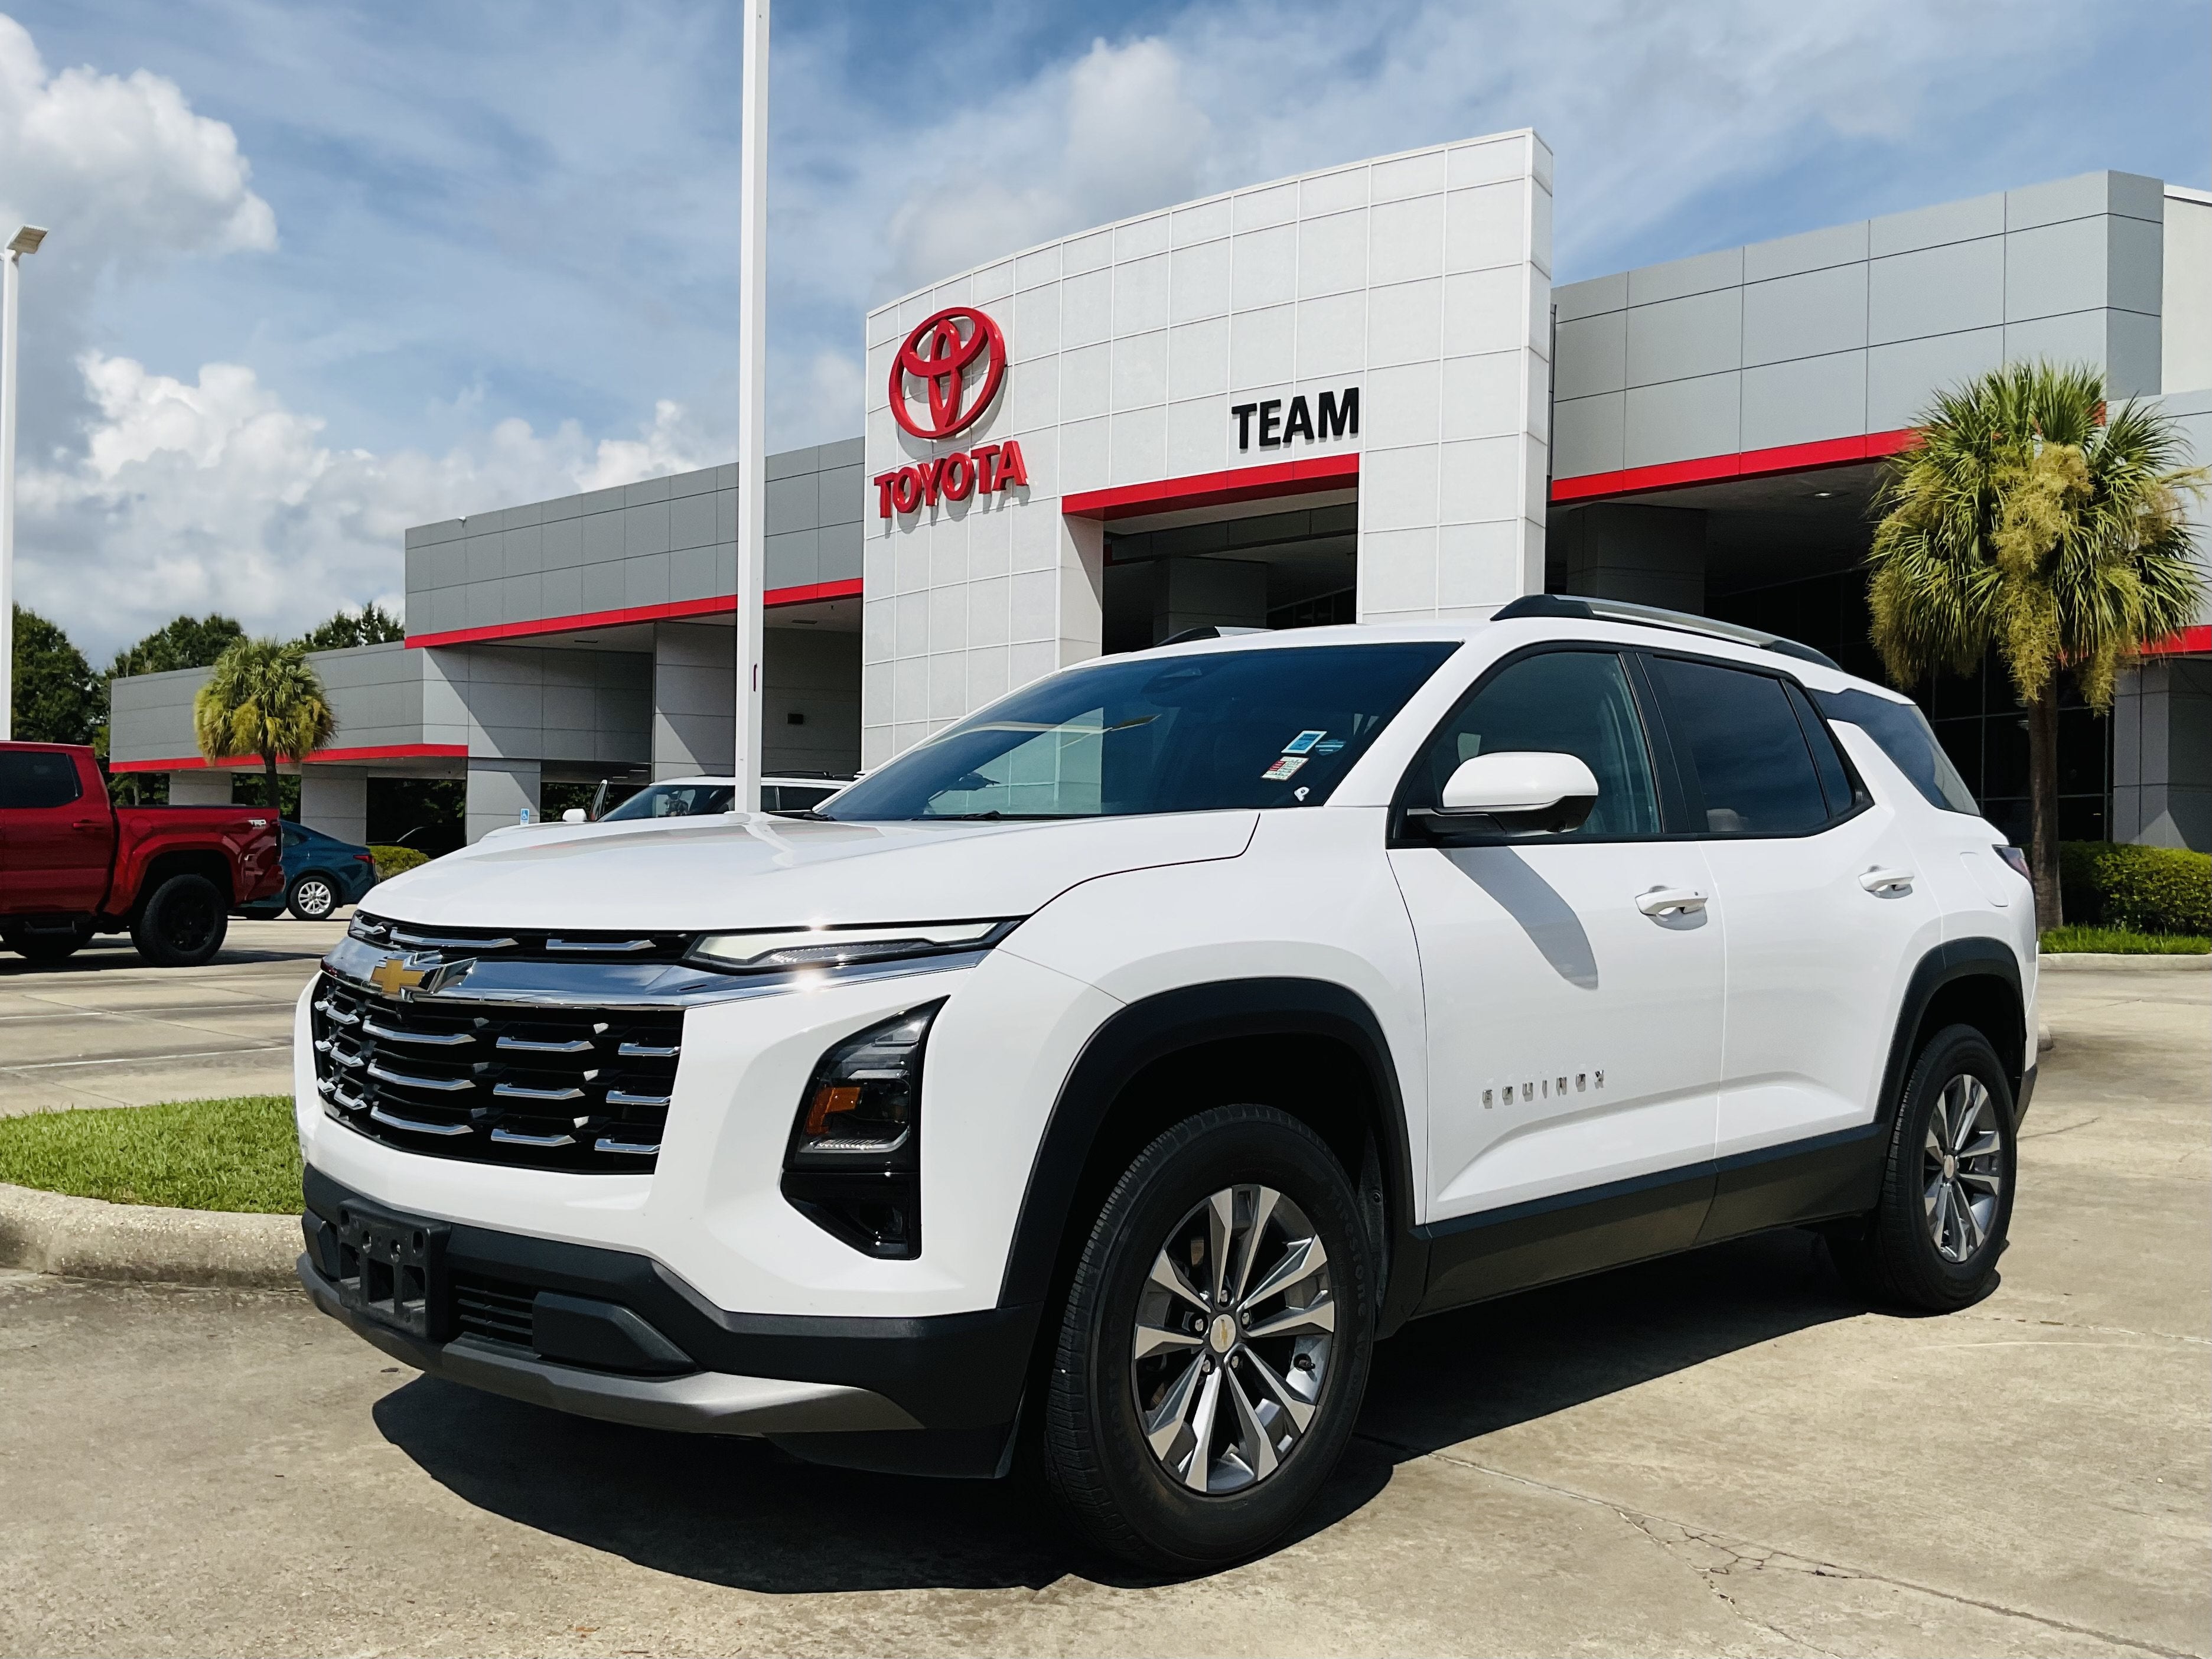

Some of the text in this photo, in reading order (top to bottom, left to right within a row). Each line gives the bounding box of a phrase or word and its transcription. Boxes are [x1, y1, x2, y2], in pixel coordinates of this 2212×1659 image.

[1232, 387, 1360, 449] TEAM
[874, 440, 1029, 519] TOYOTA
[1482, 1070, 1604, 1104] EQUINOX
